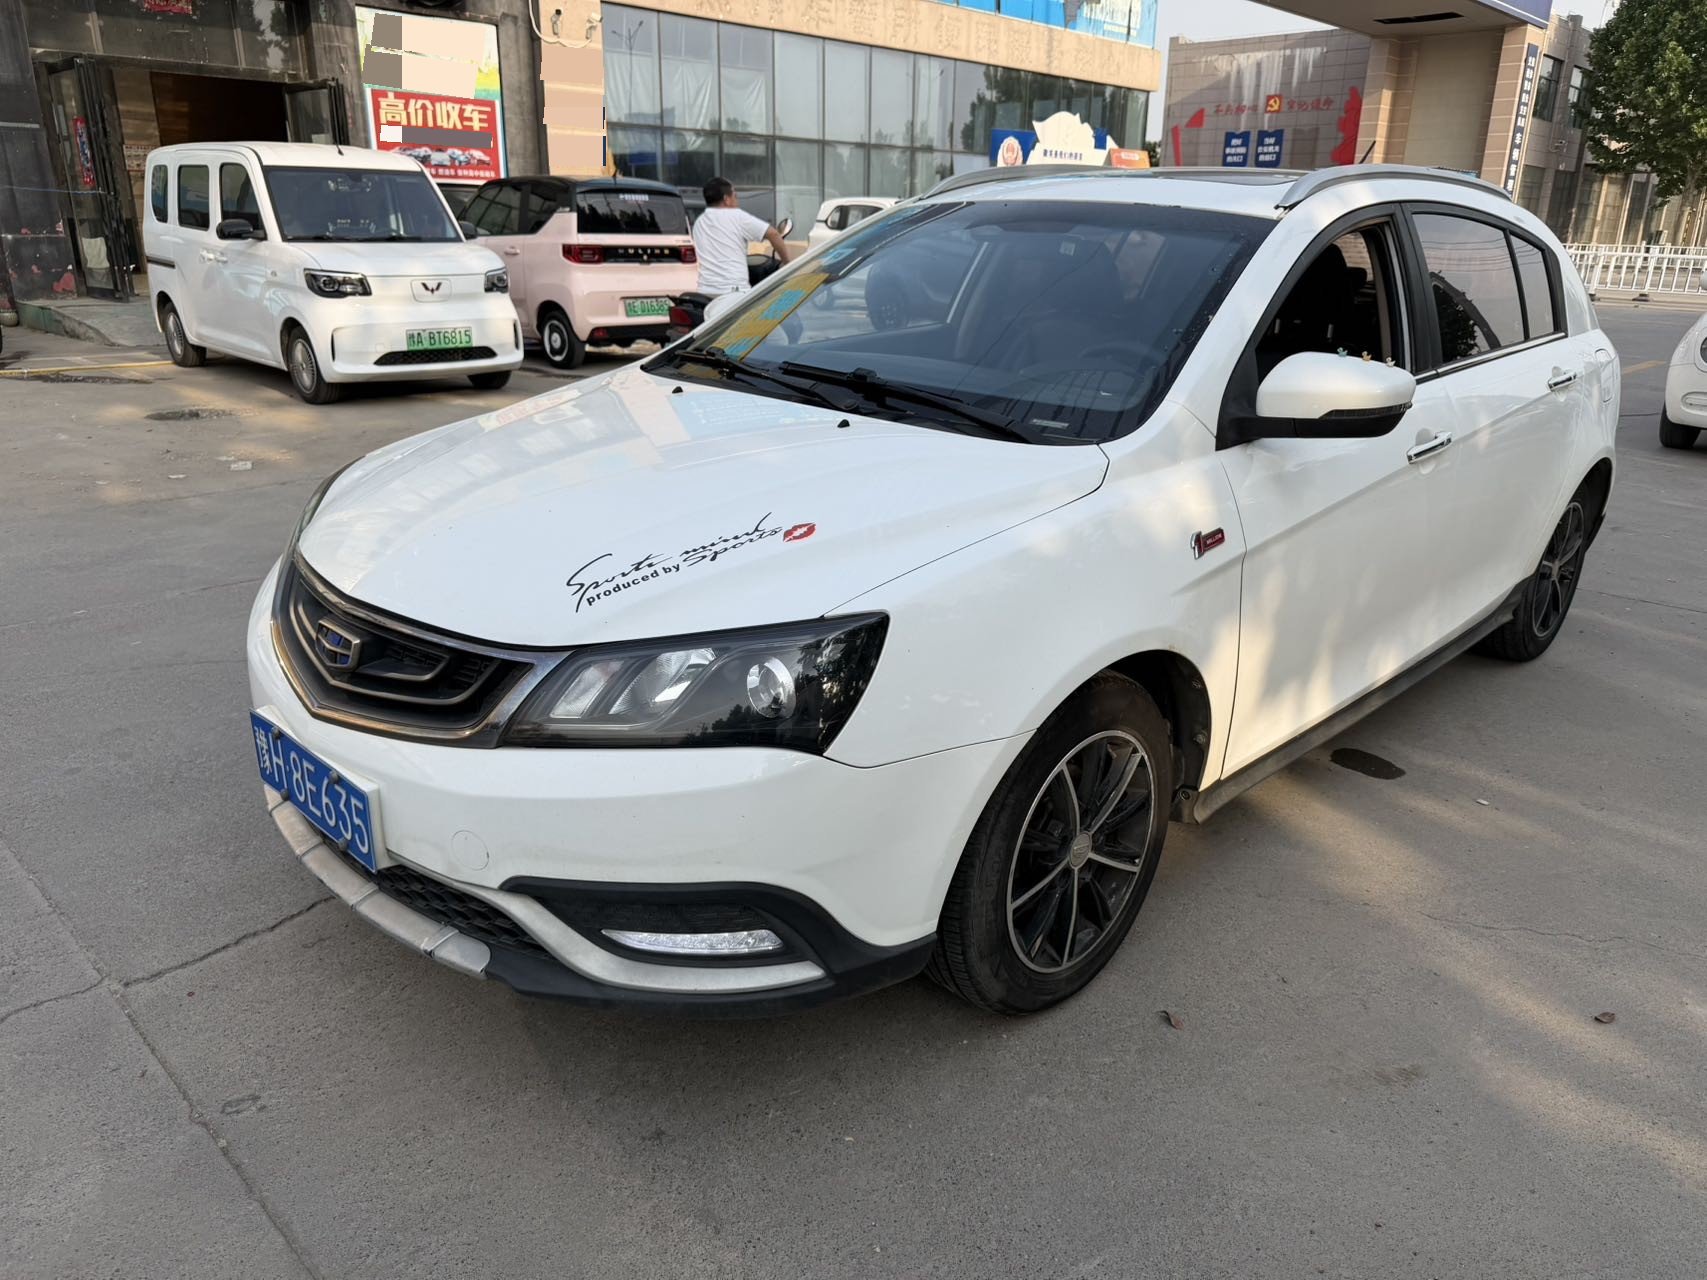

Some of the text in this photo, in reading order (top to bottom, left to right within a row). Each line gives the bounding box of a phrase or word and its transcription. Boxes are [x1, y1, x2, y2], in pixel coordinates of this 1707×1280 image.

[378, 91, 491, 131] 高价收车
[586, 527, 783, 606] produced by Sports
